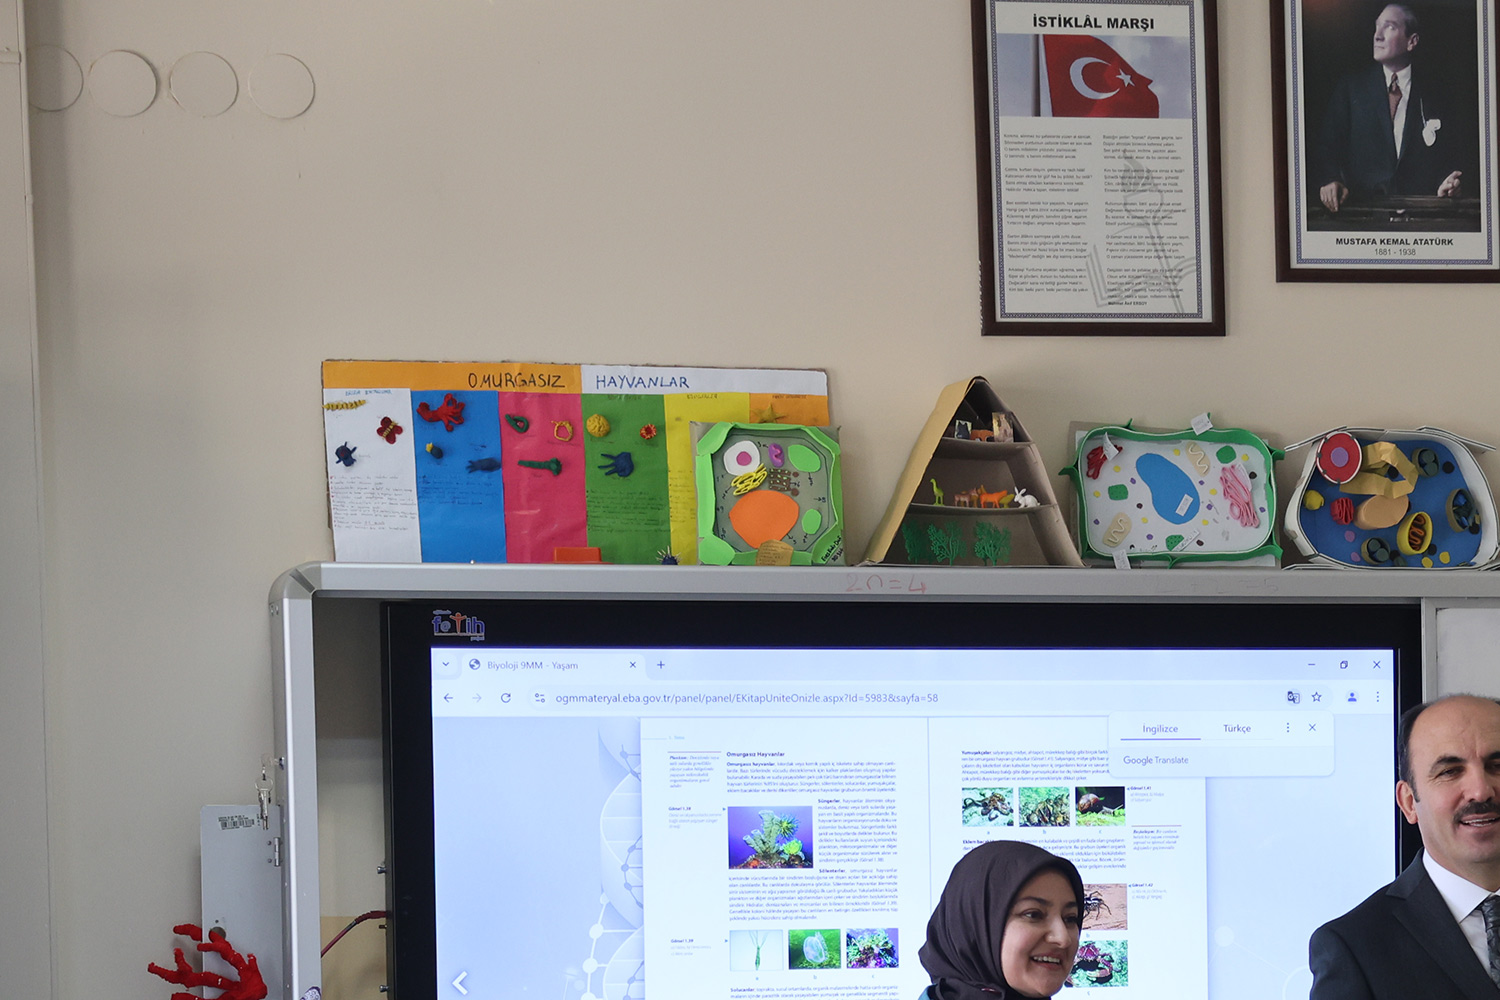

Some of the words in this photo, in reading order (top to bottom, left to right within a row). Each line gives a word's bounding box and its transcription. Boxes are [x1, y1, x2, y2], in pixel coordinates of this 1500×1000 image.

[1033, 14, 1102, 28] İSTİKLÂL
[1107, 17, 1154, 32] MARŞI
[1336, 237, 1377, 246] MUSTAFA
[1380, 238, 1411, 246] KEMAL
[1412, 237, 1454, 246] ATATÜRK
[1374, 248, 1392, 256] 1881
[1399, 248, 1416, 256] 1938
[468, 372, 565, 389] OMURGASIZ
[596, 374, 690, 390] HAYVANLAR
[487, 660, 518, 672] Biyoloji
[520, 660, 543, 670] 9MM
[551, 660, 579, 672] Yaşam
[1142, 723, 1179, 737] İngilizce
[1223, 723, 1252, 736] Türkçe
[726, 751, 756, 759] Omurgasız
[1123, 755, 1153, 767] Google
[1155, 755, 1189, 765] Translate
